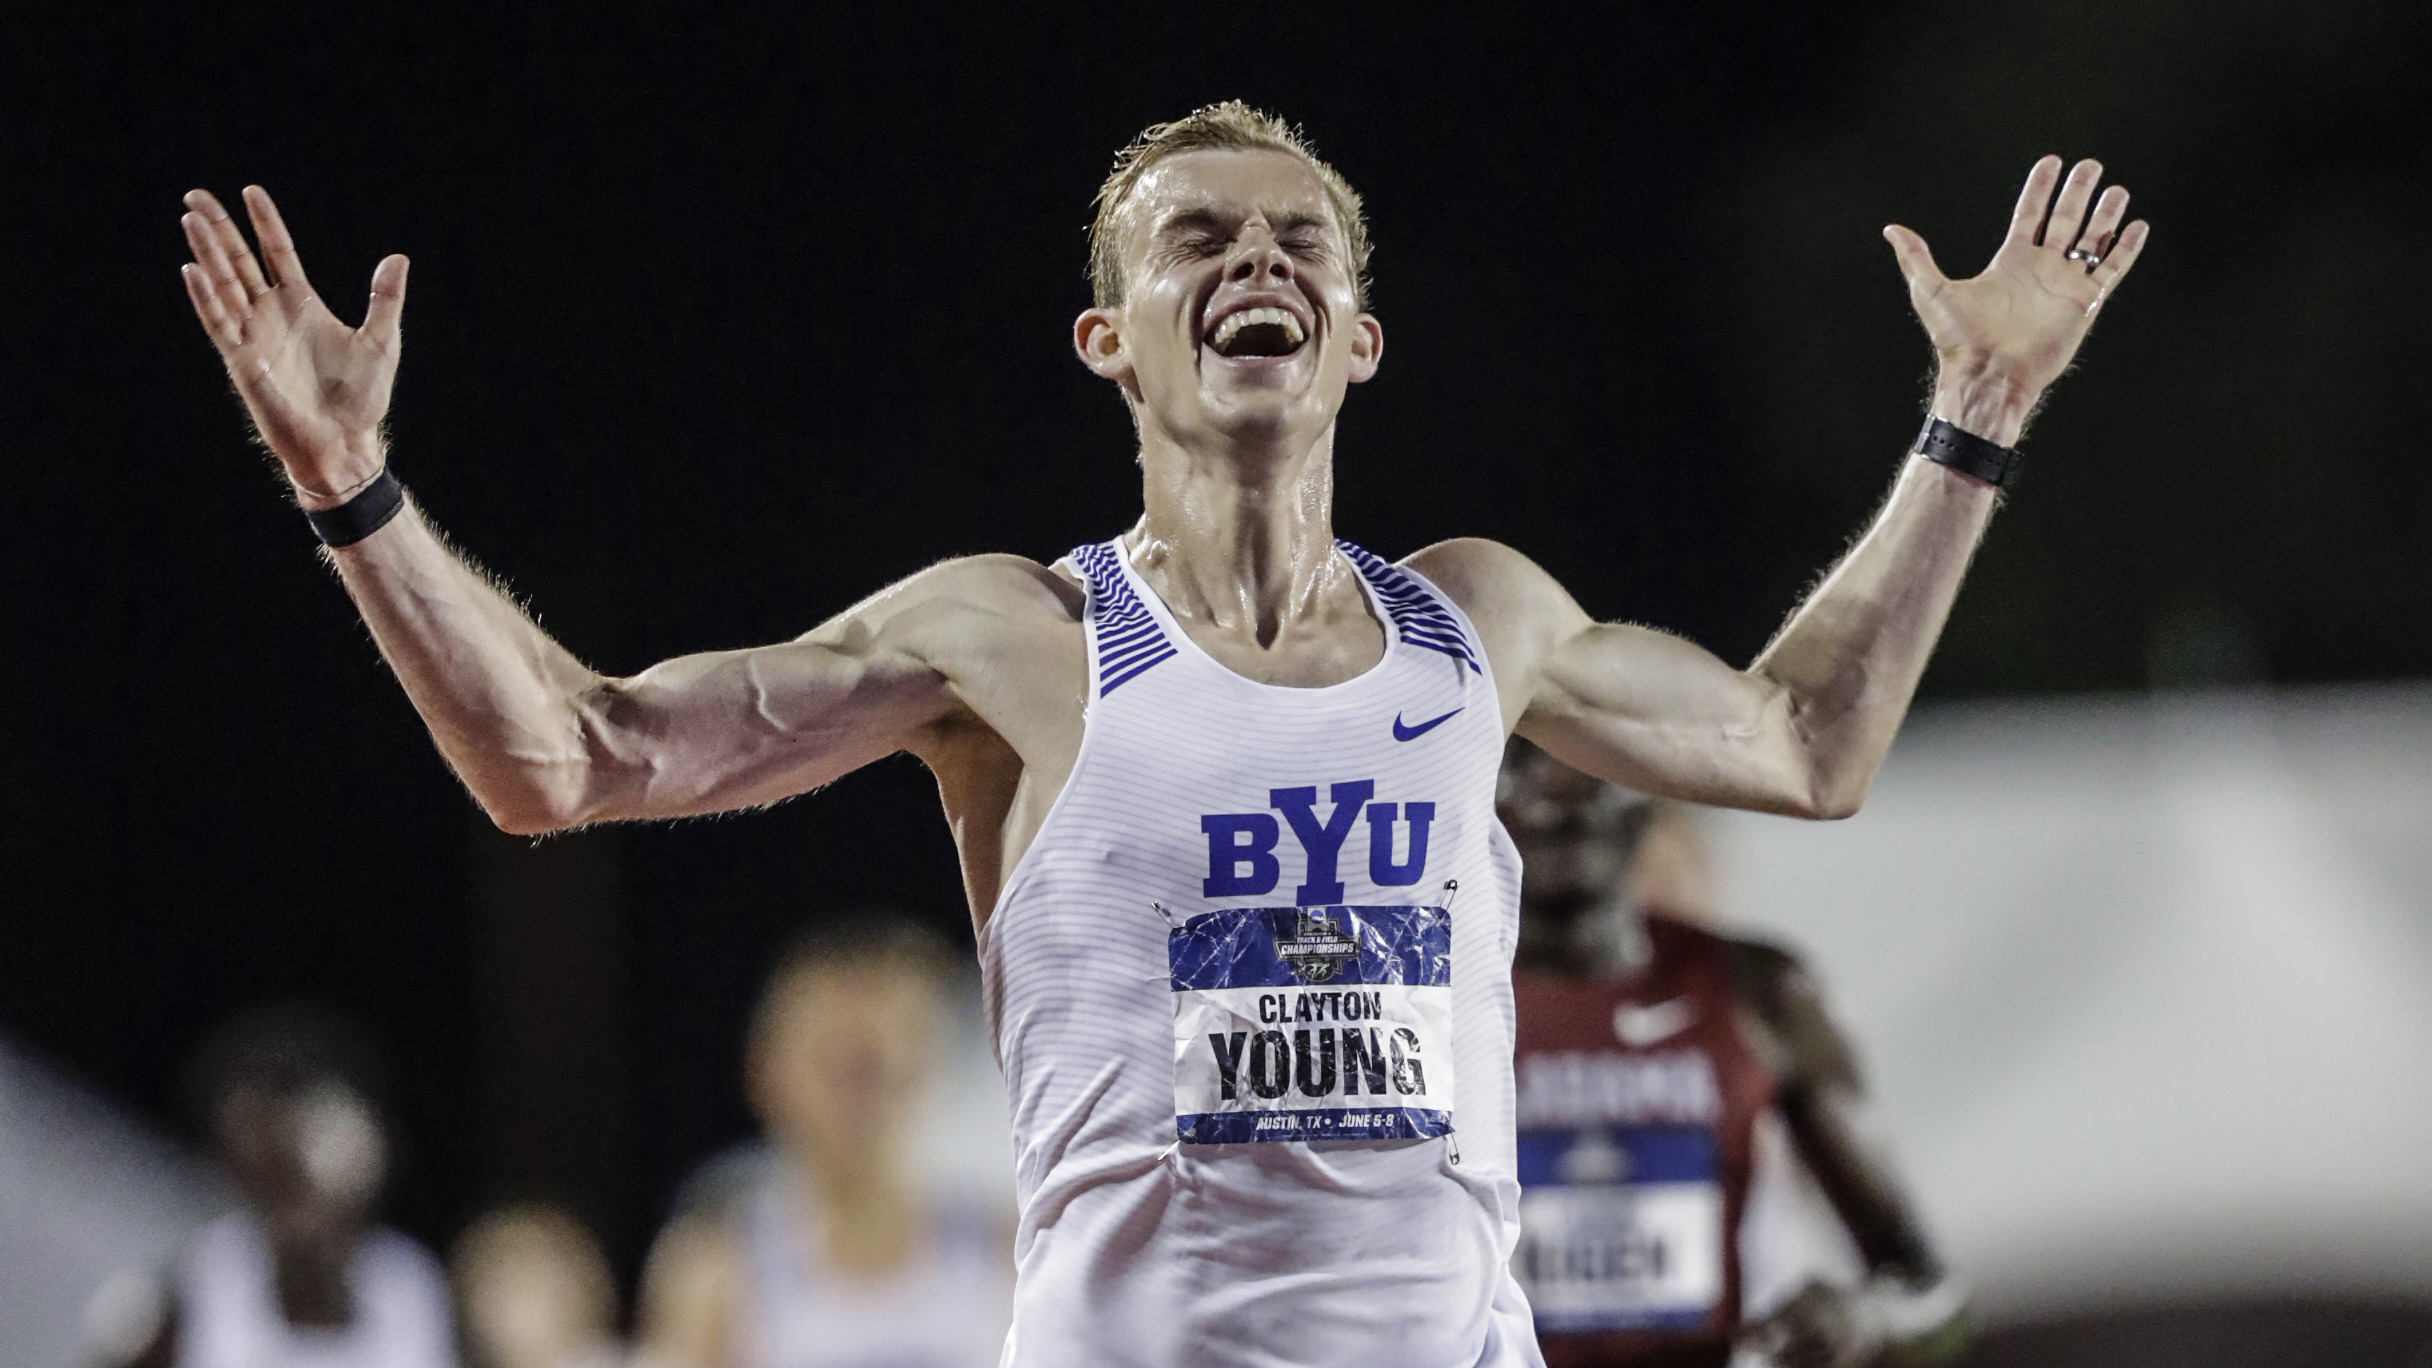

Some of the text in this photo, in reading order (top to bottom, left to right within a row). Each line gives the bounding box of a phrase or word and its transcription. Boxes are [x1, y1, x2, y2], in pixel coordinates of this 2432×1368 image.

[1201, 779, 1435, 906] BYU
[1281, 943, 1354, 955] CHAMPIONSHIPS
[1259, 991, 1381, 1024] CLAYTON
[1208, 1027, 1426, 1100] YOUNG
[1306, 1115, 1321, 1129] TX
[1338, 1114, 1370, 1127] JUNE
[1373, 1113, 1395, 1127] 5-8
